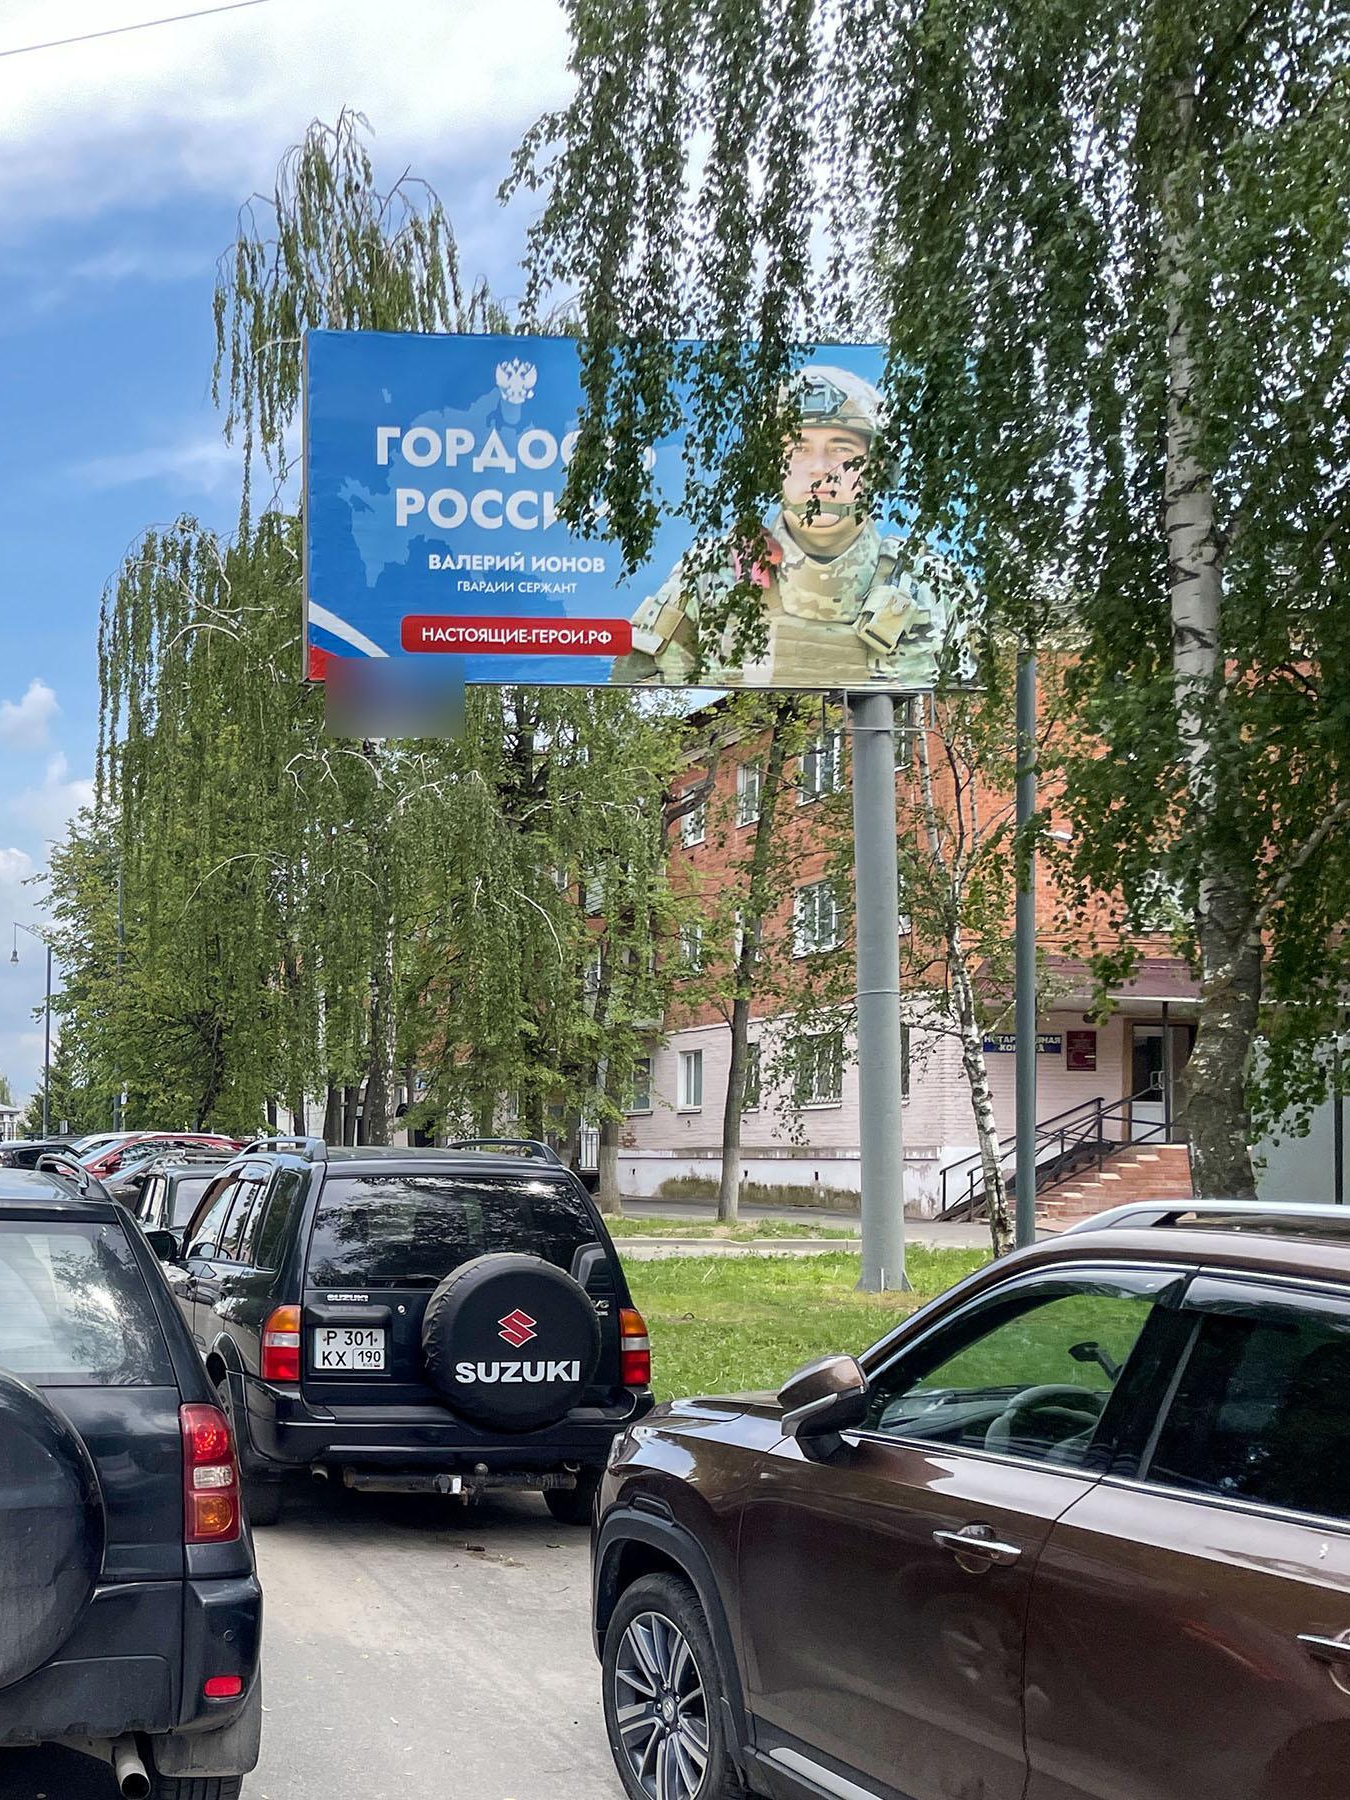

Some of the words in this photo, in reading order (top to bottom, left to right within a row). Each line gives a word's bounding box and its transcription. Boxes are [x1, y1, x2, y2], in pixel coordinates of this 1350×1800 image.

[377, 427, 657, 474] ГОРДО
[429, 552, 525, 572] ВАЛЕРИЙ
[531, 556, 606, 573] ИОНОВ
[457, 581, 514, 594] ГВАРДИИ
[518, 582, 578, 594] СЕРЖАНТ
[421, 627, 612, 645] НАСТОЯЩИЕ-ГЕРОИ.РФ
[327, 1294, 369, 1302] SUZUKI
[344, 1330, 374, 1346] 301
[357, 1350, 381, 1362] 190
[455, 1361, 581, 1383] SUZUKI
